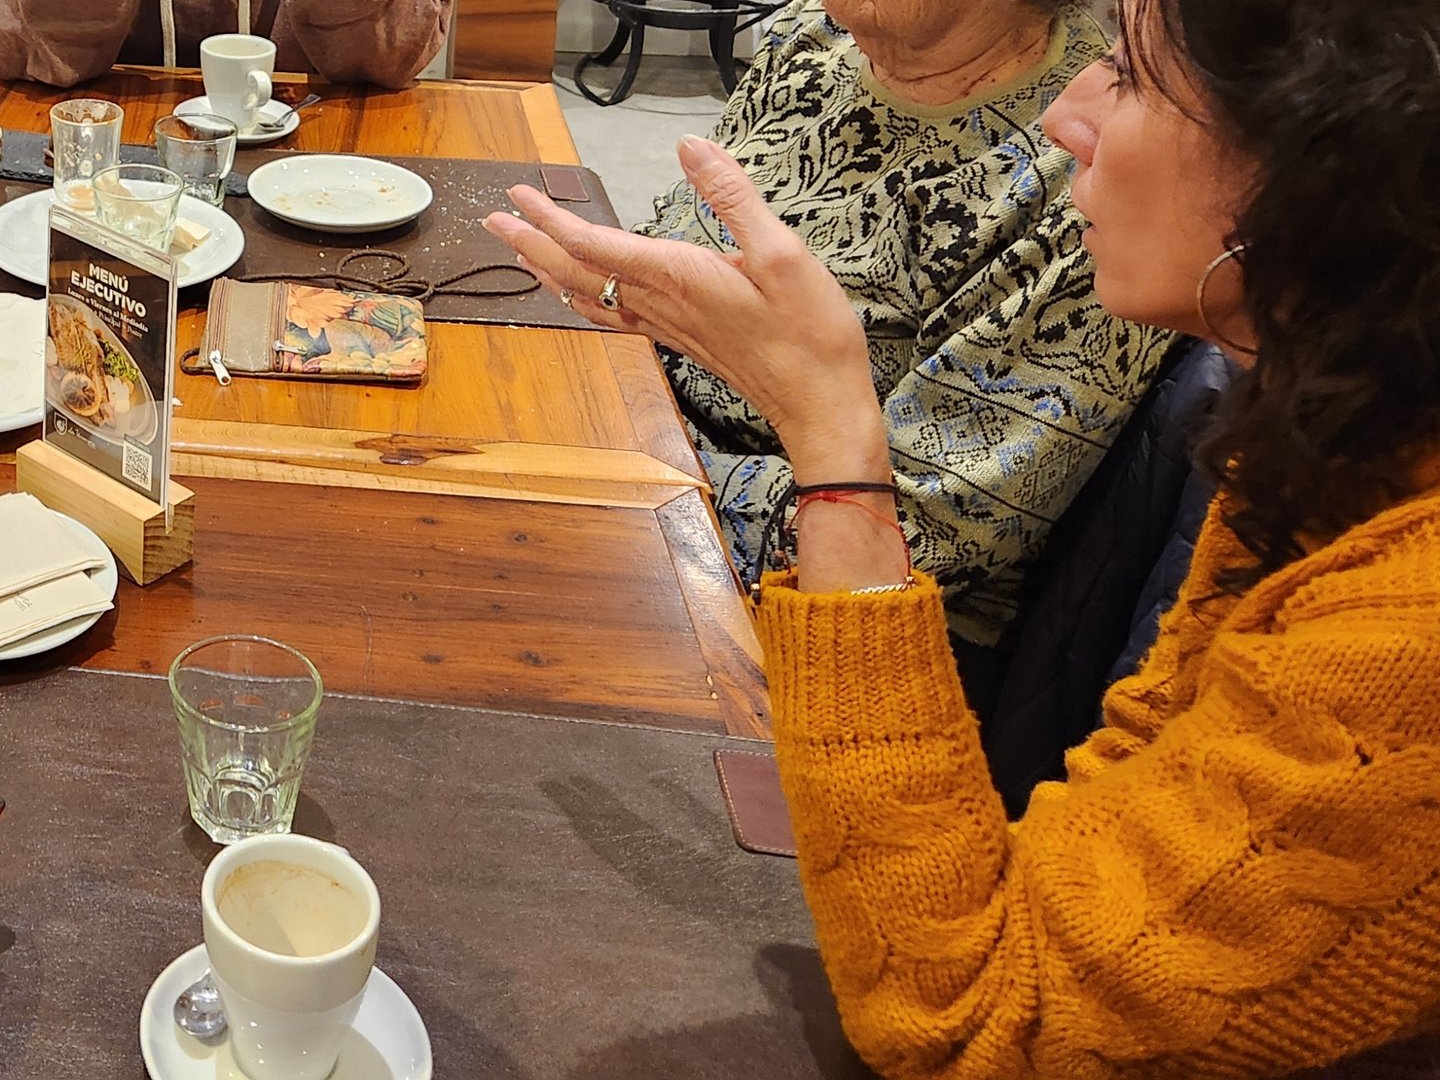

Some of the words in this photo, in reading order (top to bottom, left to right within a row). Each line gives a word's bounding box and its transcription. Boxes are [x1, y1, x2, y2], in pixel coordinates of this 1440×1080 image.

[89, 262, 129, 293] MENÚ
[67, 287, 85, 301] Lunes
[90, 298, 113, 315] Viernes
[71, 270, 147, 318] EJECUTIVO
